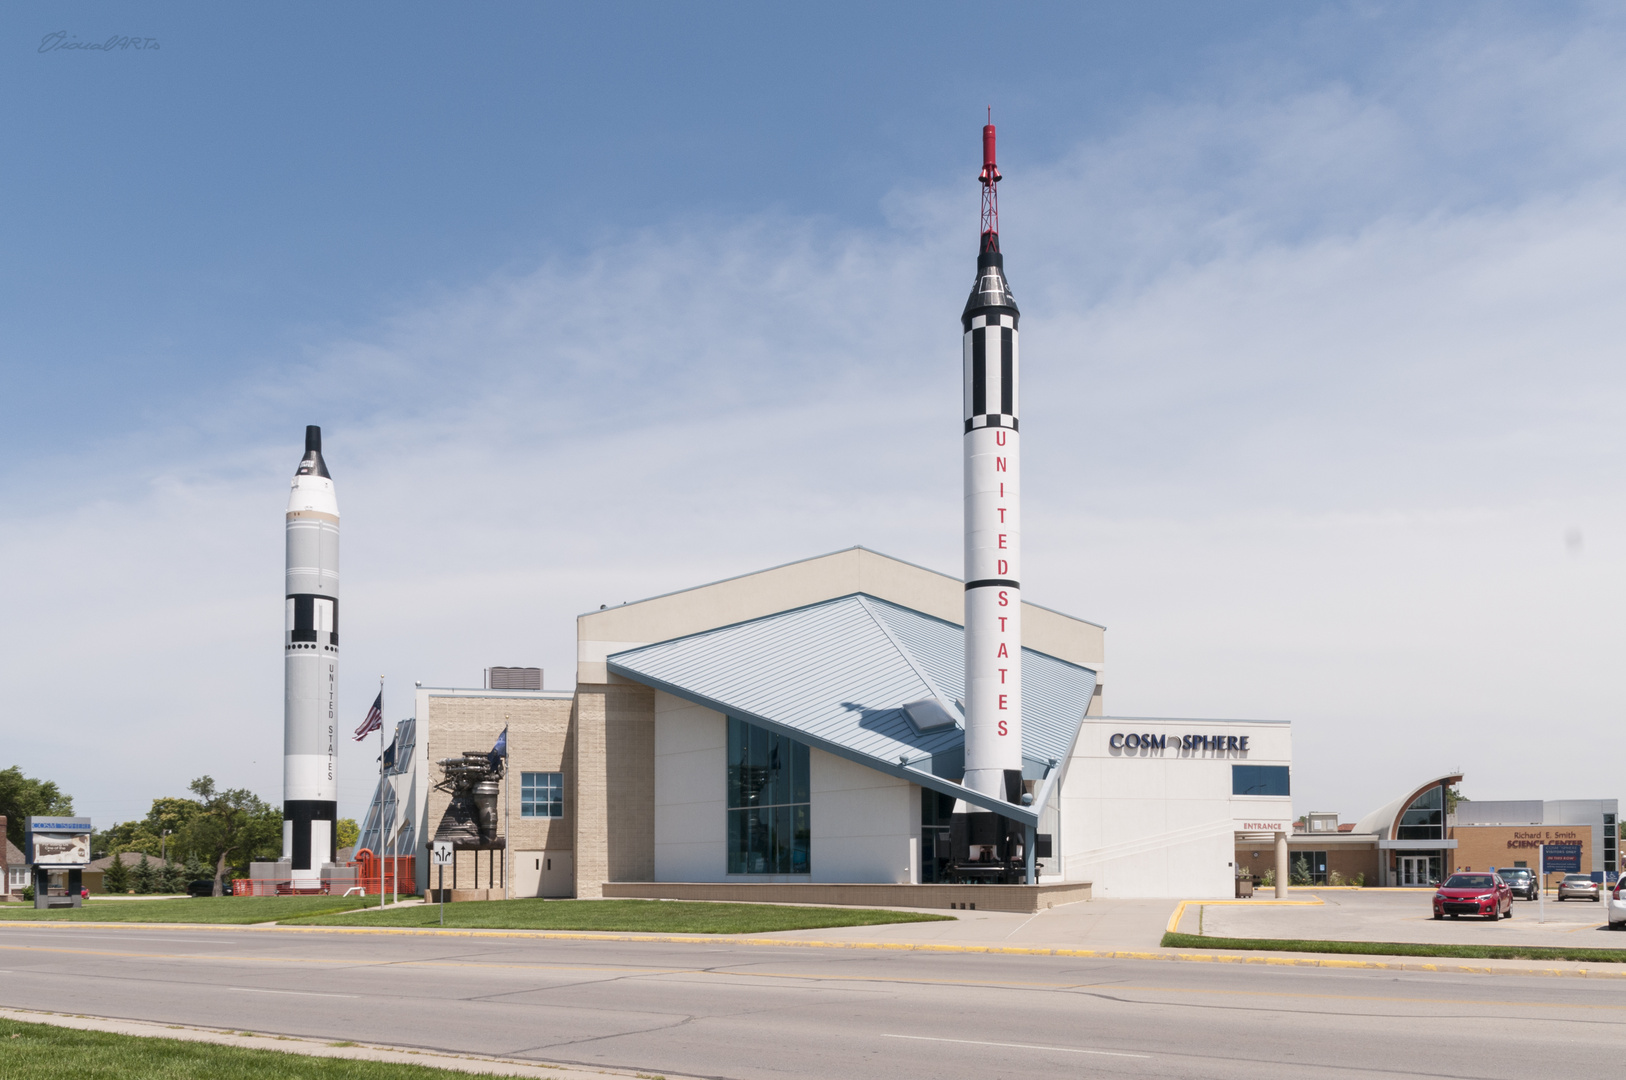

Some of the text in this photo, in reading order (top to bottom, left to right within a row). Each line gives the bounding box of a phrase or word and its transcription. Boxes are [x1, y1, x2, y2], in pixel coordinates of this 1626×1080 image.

[996, 430, 1009, 575] UNITED
[997, 590, 1009, 737] STATES
[1243, 822, 1282, 830] ENTRANCE
[1514, 831, 1542, 839] Richard
[1554, 831, 1576, 839] Smith
[1507, 840, 1583, 849] SCIENCE CENTER
